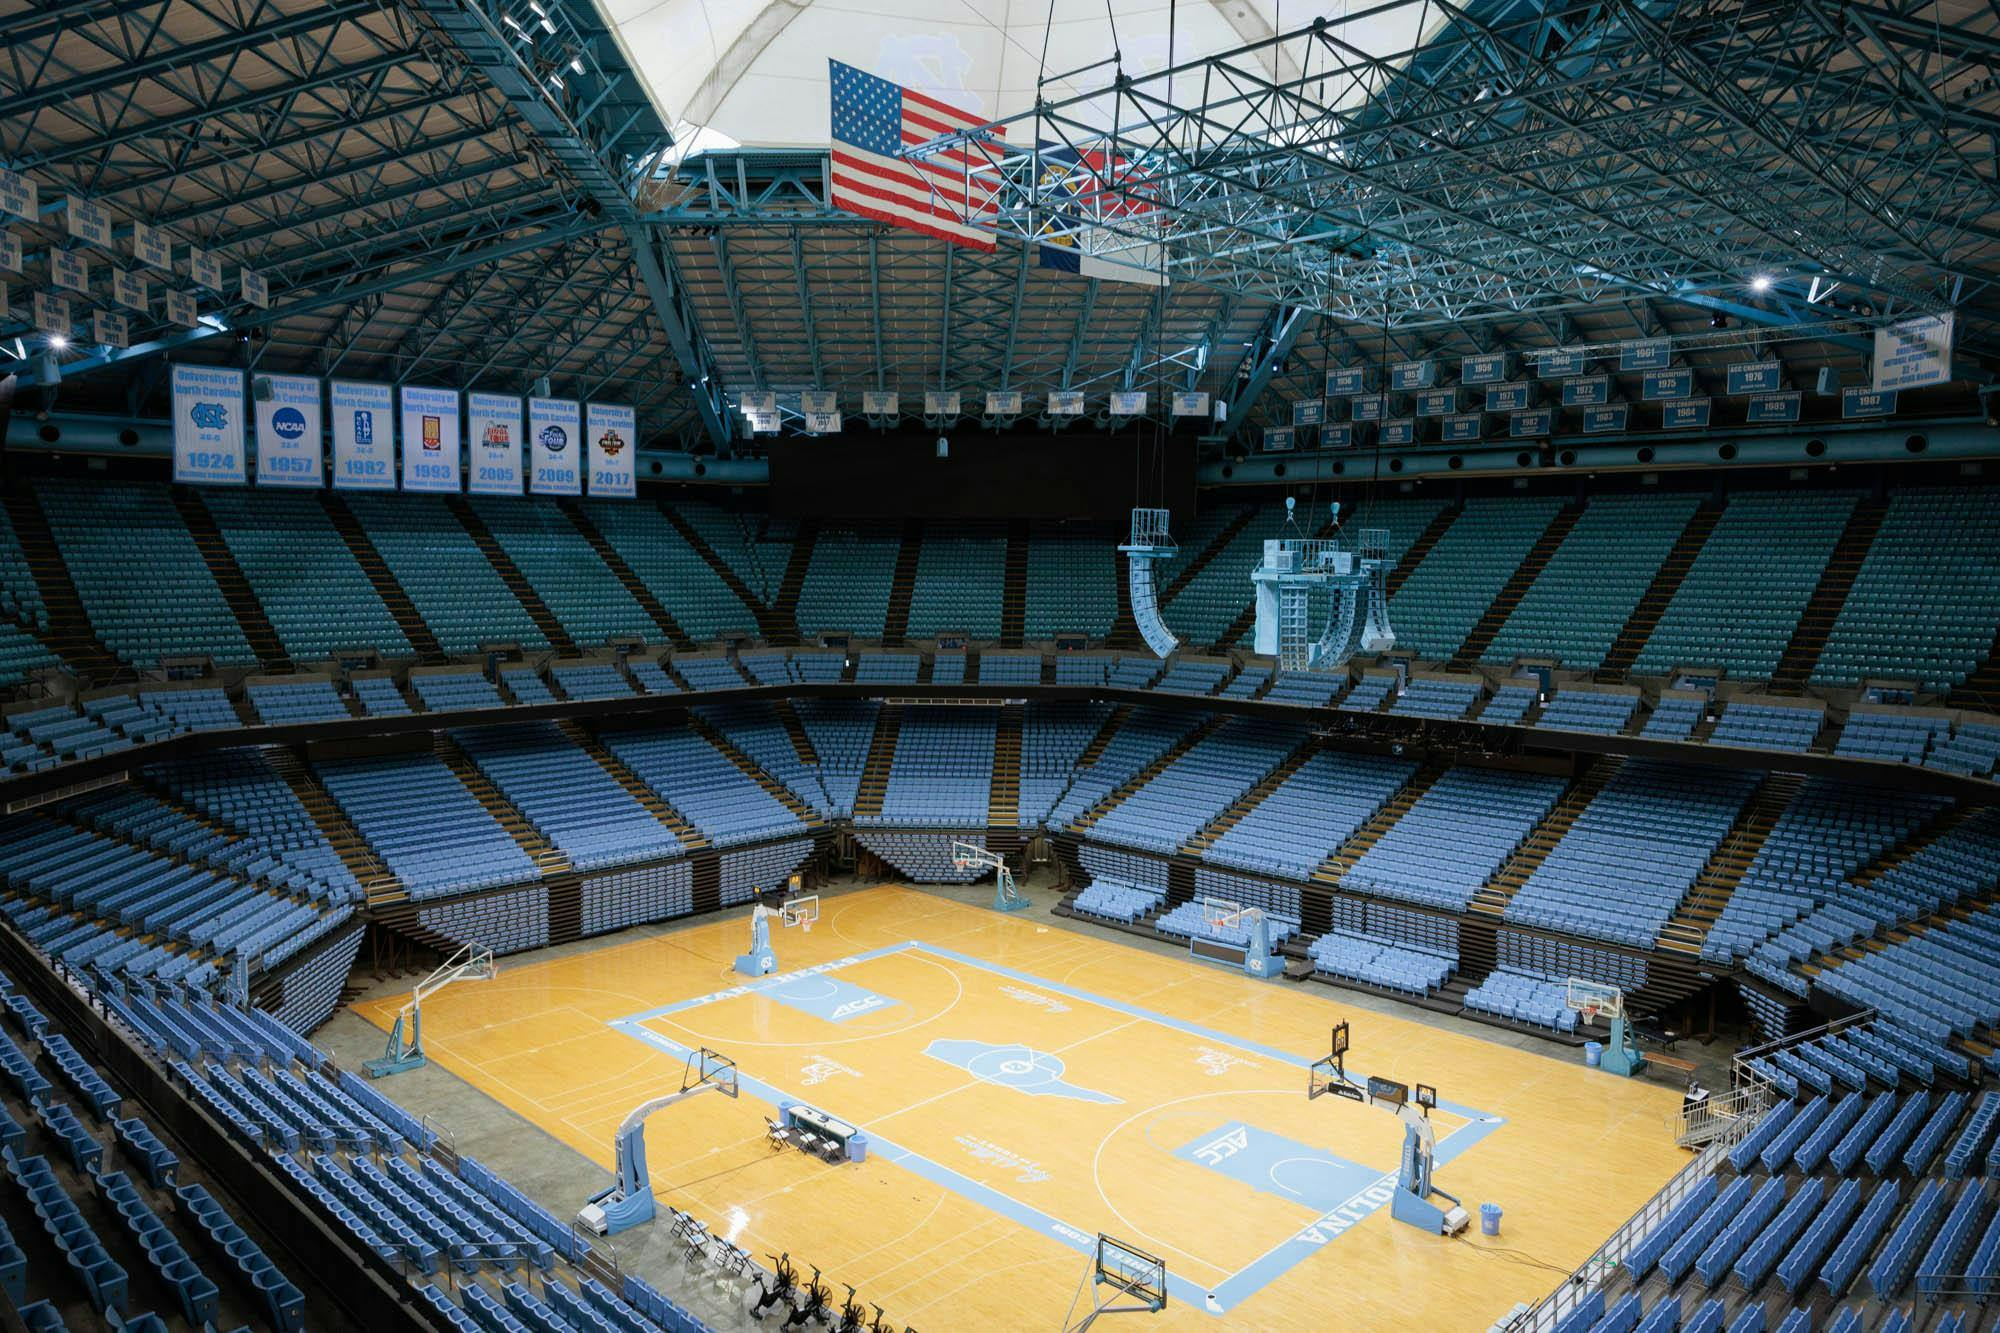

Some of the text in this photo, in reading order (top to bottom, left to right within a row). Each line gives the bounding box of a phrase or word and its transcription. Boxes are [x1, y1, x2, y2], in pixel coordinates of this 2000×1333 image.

[178, 371, 238, 385] University of
[175, 384, 242, 398] North Carolina
[306, 382, 315, 392] of
[336, 384, 388, 398] University of
[283, 393, 319, 404] Carolina
[333, 396, 391, 410] North Carolina
[407, 391, 455, 404] University of
[473, 396, 518, 409] University of
[404, 403, 457, 415] North Carolina
[534, 400, 576, 412] University of
[592, 407, 623, 418] University
[471, 407, 520, 420] North Carolina
[531, 412, 578, 423] North Carolina
[276, 421, 305, 432] NCAA
[589, 417, 634, 429] North Carolina
[188, 452, 235, 470] 1924
[269, 456, 313, 473] 1957
[346, 459, 386, 475] 1982
[414, 464, 451, 480] 1993
[479, 467, 514, 481] 2005
[538, 468, 575, 483] 2009
[595, 471, 630, 485] 2017
[692, 957, 859, 1005] TAR HEELS
[831, 995, 884, 1019] ACC
[1192, 1127, 1248, 1167] ACC
